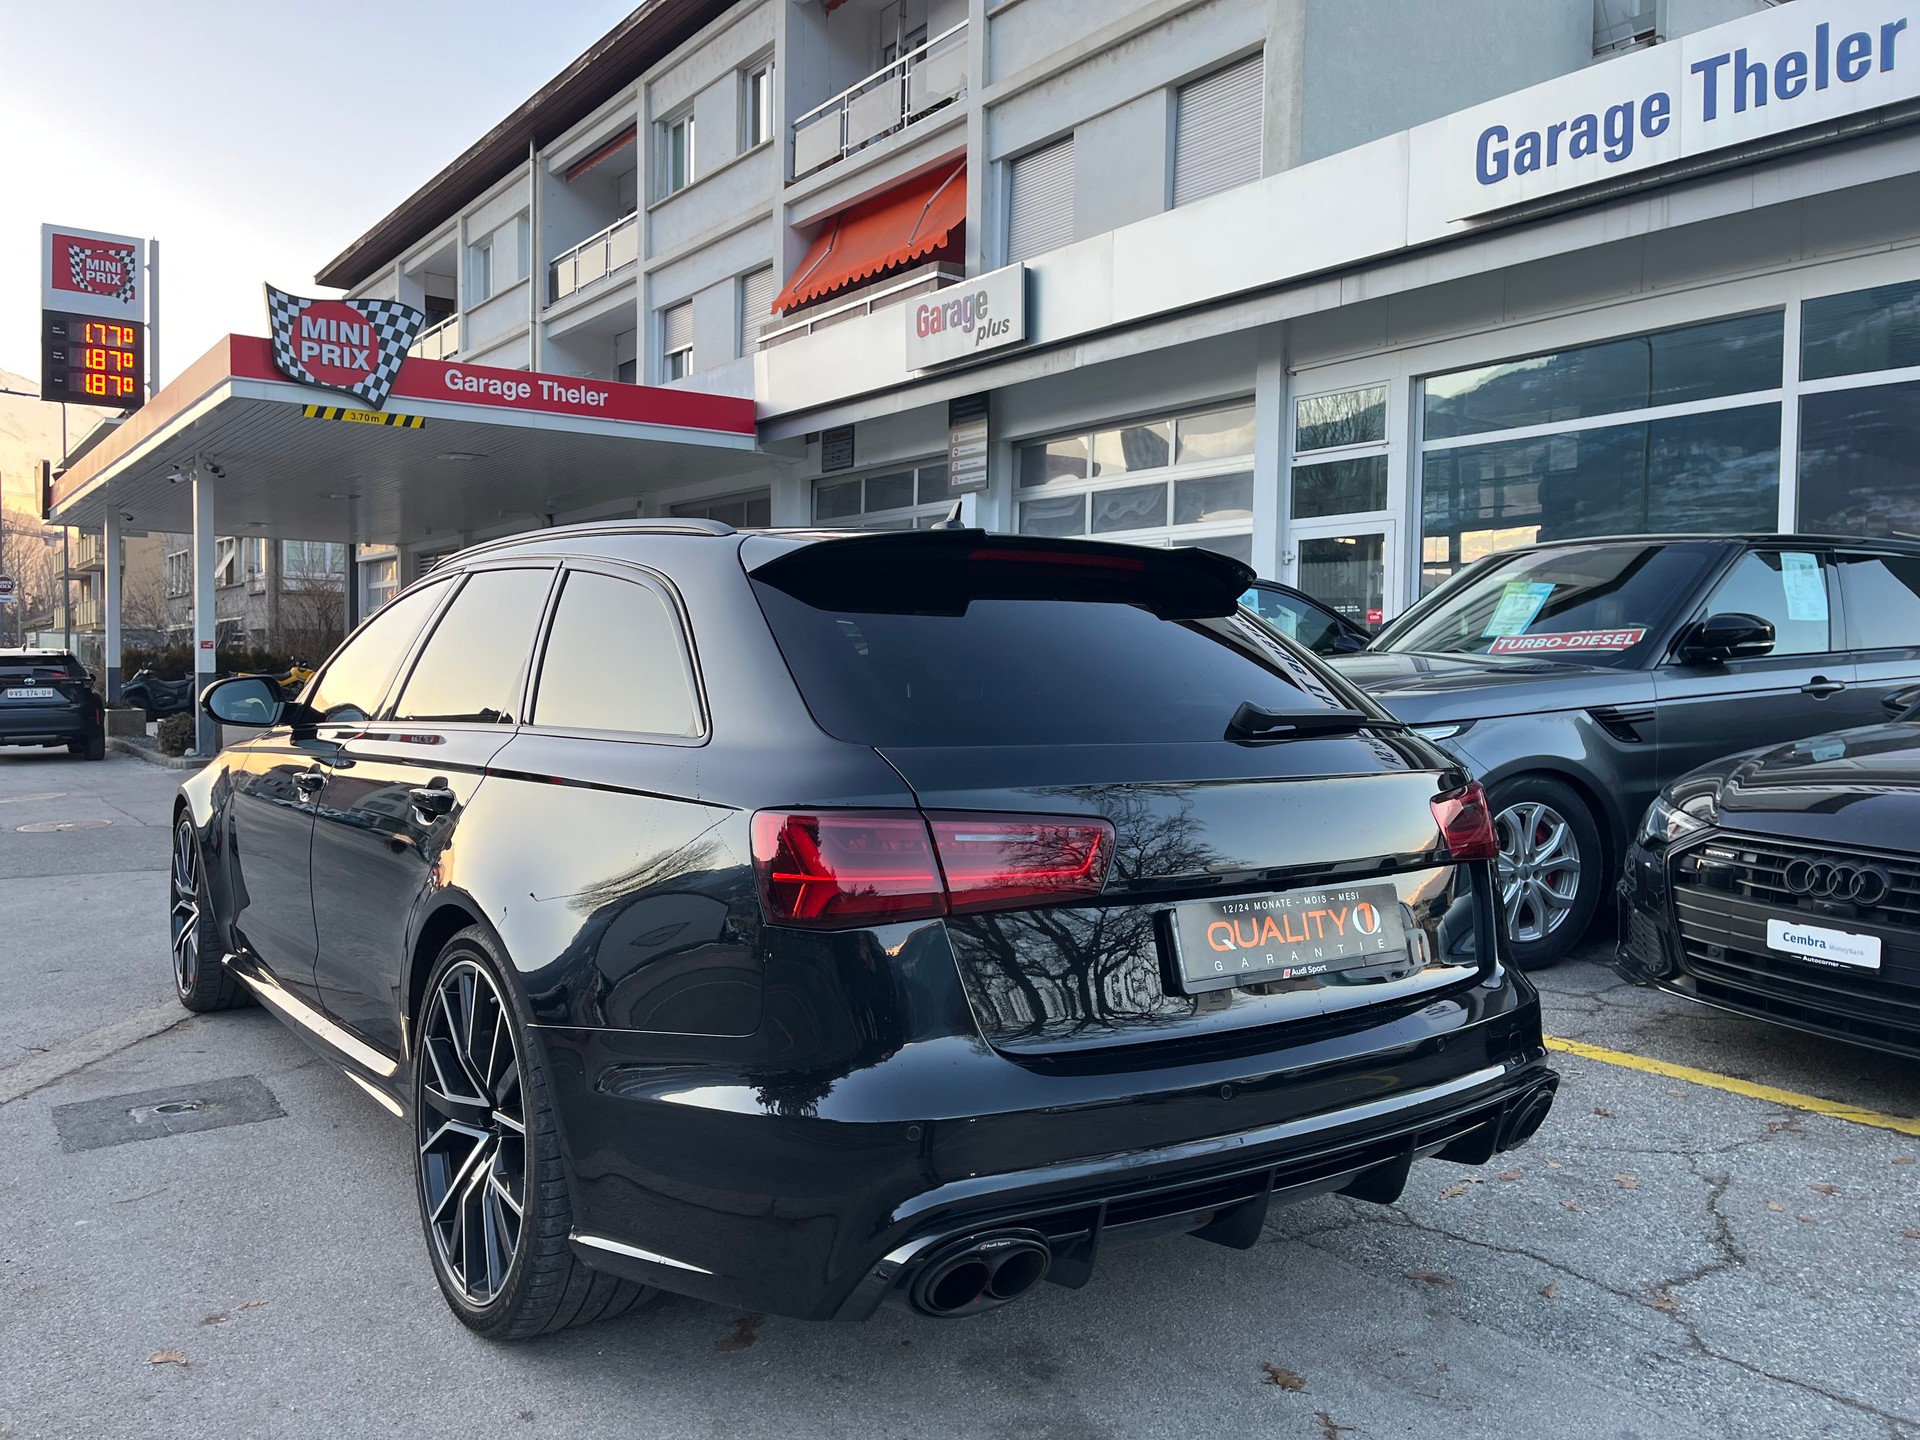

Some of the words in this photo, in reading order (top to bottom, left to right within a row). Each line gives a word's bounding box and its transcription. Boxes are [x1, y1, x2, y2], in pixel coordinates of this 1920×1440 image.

[1475, 91, 1671, 186] Garage
[1690, 17, 1908, 122] Theler
[86, 258, 121, 274] MINI
[86, 270, 121, 285] PRIX
[916, 290, 988, 338] Garage
[301, 315, 370, 347] MINI
[975, 316, 1010, 346] plus
[301, 340, 371, 371] PRIX
[444, 368, 531, 401] Garage
[538, 380, 609, 407] Theler
[1498, 633, 1635, 651] TURBO-DIESEL
[1222, 903, 1250, 914] 12/24
[1253, 899, 1292, 911] MONATE
[1304, 895, 1327, 905] MOIS
[1338, 891, 1360, 901] MESI
[1207, 907, 1348, 952] QUALITY
[1782, 932, 1827, 949] Cembra
[1214, 939, 1385, 972] GARANTIE
[1291, 966, 1307, 976] Audi
[1307, 964, 1328, 974] Sport
[1802, 955, 1840, 967] Autocorner
